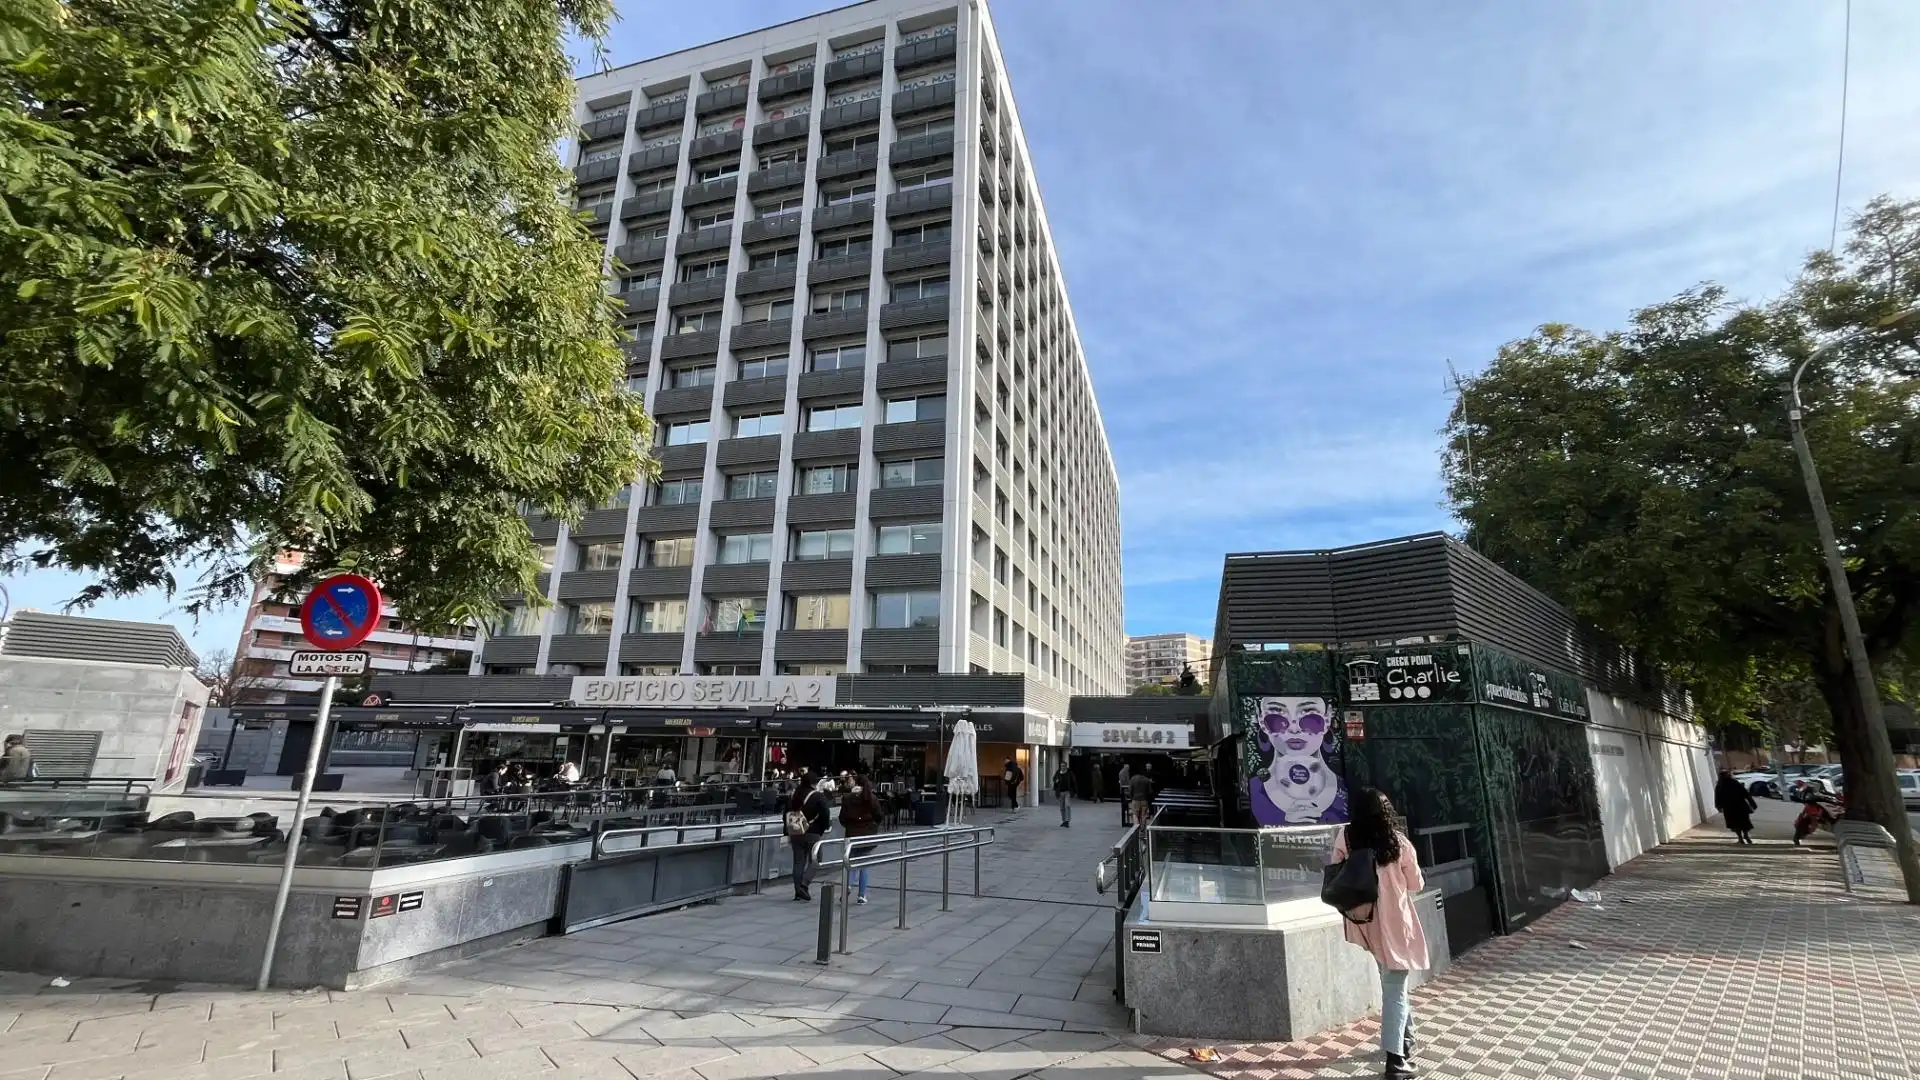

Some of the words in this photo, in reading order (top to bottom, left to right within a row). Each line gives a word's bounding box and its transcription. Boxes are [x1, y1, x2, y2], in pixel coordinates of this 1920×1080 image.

[298, 654, 343, 662] MOTOS
[346, 654, 363, 662] EN
[1386, 656, 1410, 667] CHECK
[1410, 655, 1433, 667] POINT
[297, 665, 312, 673] LA
[1386, 662, 1461, 685] Charlie
[584, 680, 686, 703] EDIFICIO
[692, 680, 799, 703] SEVILLA
[807, 680, 821, 703] 2
[1102, 728, 1163, 744] SEVILLA
[1166, 730, 1176, 744] 2
[1270, 833, 1326, 845] TENTACI
